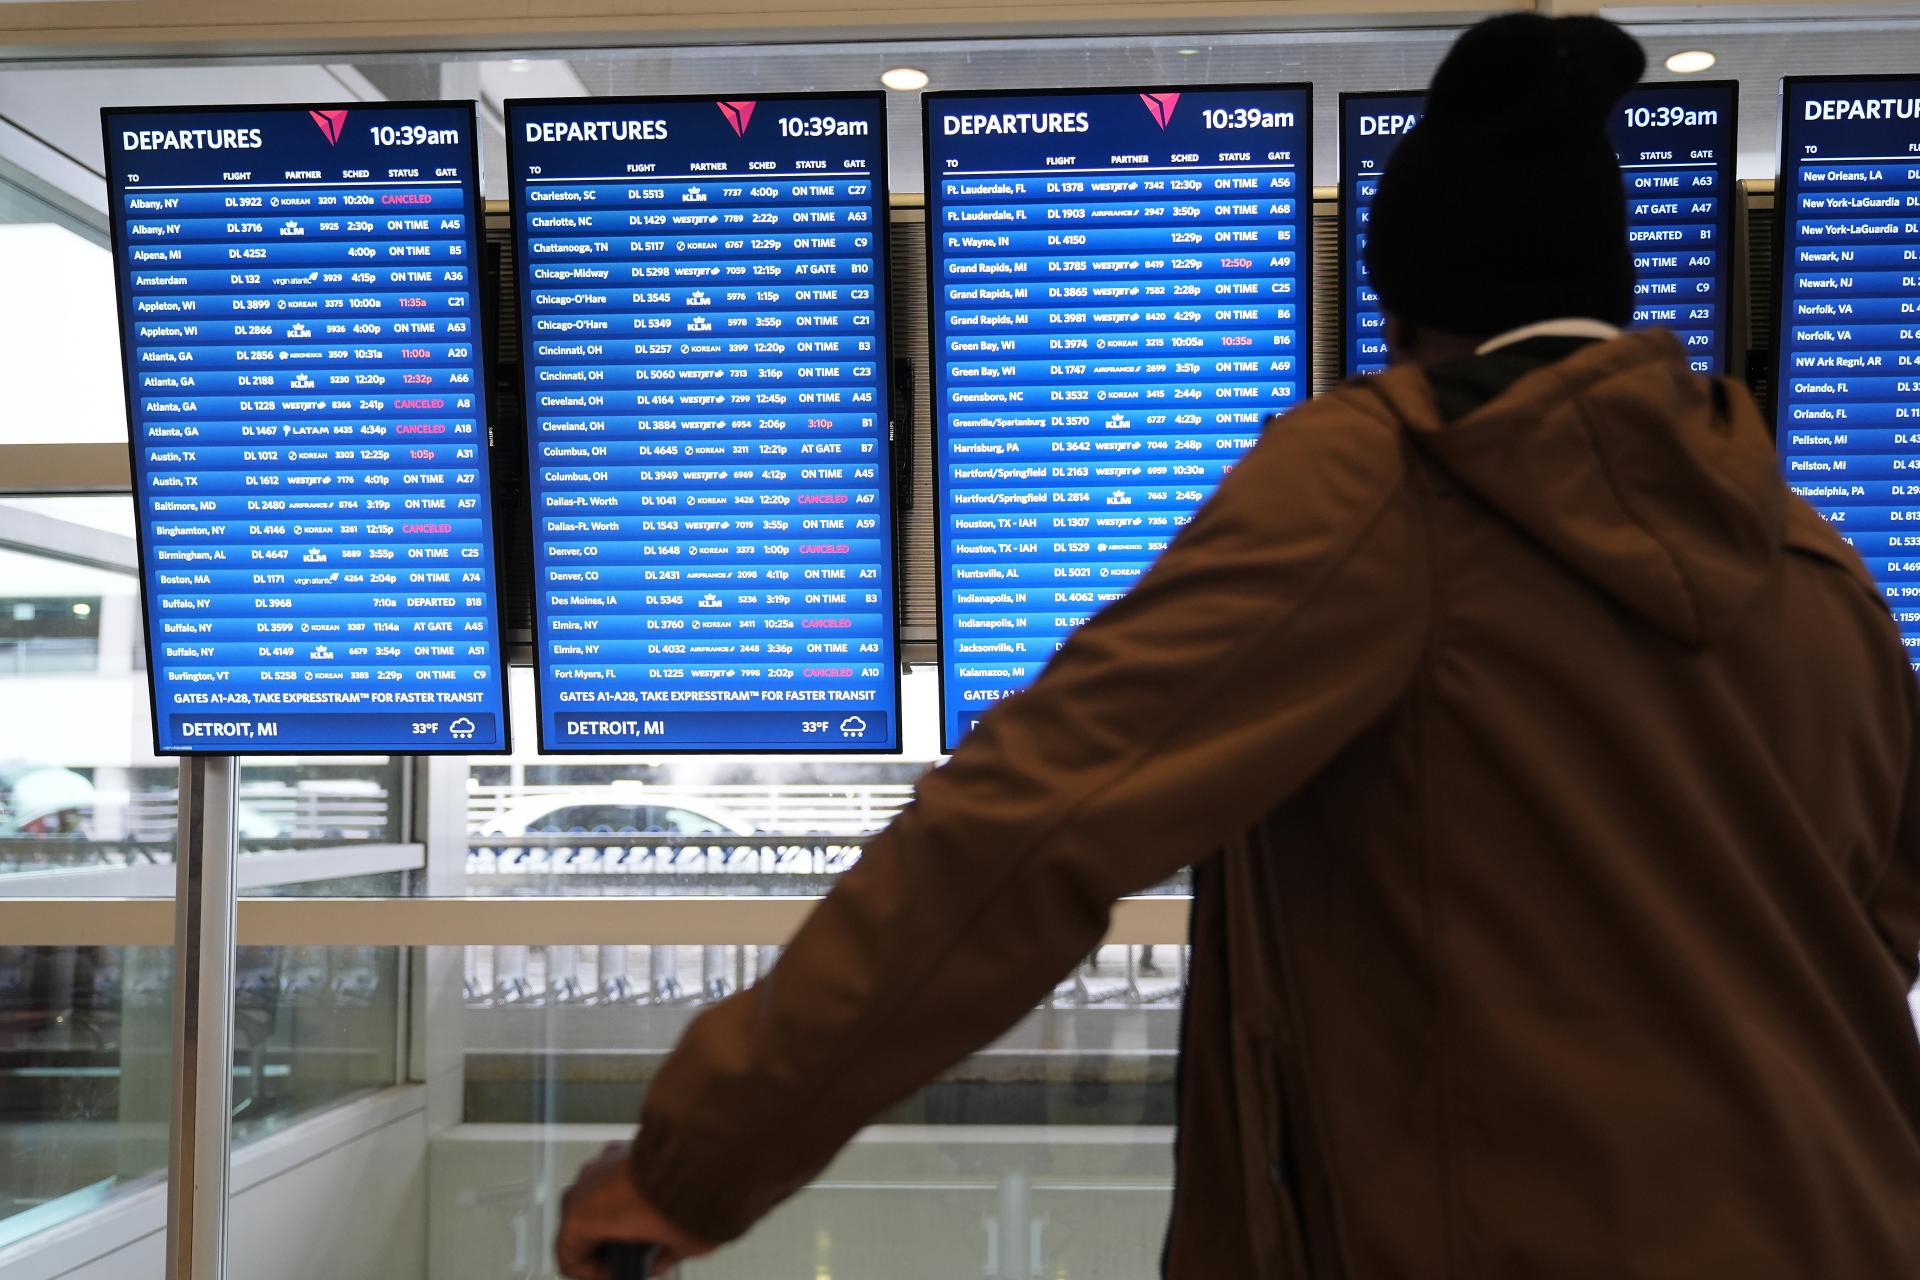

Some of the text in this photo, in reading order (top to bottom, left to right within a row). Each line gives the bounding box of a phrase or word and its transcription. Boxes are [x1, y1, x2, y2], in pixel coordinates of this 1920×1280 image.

[1202, 108, 1294, 129] 10:39am
[1624, 106, 1718, 128] 10:39am
[778, 116, 868, 137] 10:39am
[943, 112, 1089, 136] DEPARTURES
[370, 125, 459, 146] 10:39am
[525, 119, 668, 143] DEPARTURES
[122, 128, 263, 151] DEPARTURES
[1639, 149, 1713, 161] STATUS GATE
[1804, 145, 1818, 154] TO
[945, 151, 1291, 168] TO FLIGHT PARTNER SCHED STATUS GATE
[1361, 159, 1374, 169] TO
[528, 159, 866, 175] TO FLIGHT PARTNER SCHED STATUS GATE
[127, 168, 458, 183] TO FLIGHT PARTNER SCHED STATUS GATE
[1803, 170, 1883, 182] New Orleans, LA
[946, 177, 1291, 195] Ft. Lauderdale, FL DL 1378 12:30p ON TIME A56
[1634, 176, 1713, 188] ON TIME A63
[129, 198, 164, 210] Albany,
[164, 198, 179, 208] NY
[225, 197, 239, 207] DL
[239, 196, 263, 207] 3922
[281, 198, 311, 206] KOREAN
[342, 194, 375, 205] 10:20a
[380, 193, 433, 205] CANCELED
[1802, 196, 1900, 208] New York-LaGuardia
[1634, 203, 1712, 215] AT GATE A47
[532, 211, 868, 228] Charlotte, NC DL 1429 2:22p ON TIME A63
[1629, 229, 1711, 242] DEPARTED B1
[533, 242, 718, 254] Chattanooga, TN KOREAN
[1800, 251, 1854, 262] Newark, NJ
[948, 256, 1291, 275] Grand Rapids, MI 12:50p A49
[136, 271, 464, 286] Amsterdam DL 132 4:15p ON TIME A36
[1633, 309, 1710, 321] ON TIME A23
[1798, 304, 1853, 315] Norfolk, VA
[1362, 317, 1379, 327] Los
[1107, 335, 1291, 348] KOREAN B16
[1687, 335, 1709, 346] A70
[1362, 343, 1379, 353] Los
[142, 348, 431, 363] Atlanta, GA 11:00a
[1690, 361, 1708, 372] C15
[1796, 356, 1882, 368] NW Ark Regnl, AR
[1794, 382, 1849, 394] Orlando, FL
[951, 391, 1024, 403] Greensboro, NC
[292, 423, 473, 435] LATAM CANCELED A18
[542, 418, 833, 432] Cleveland, OH 3:10p
[1792, 434, 1848, 446] Pellston, MI
[1851, 486, 1865, 496] PA
[546, 493, 875, 507] Dallas-Ft. Worth 12:20p CANCELED A67
[156, 525, 226, 537] Binghamton, NY
[956, 568, 1019, 579] Huntsville, AL
[406, 597, 483, 607] DEPARTED B18
[554, 668, 617, 680] Fort Myers, FL
[959, 666, 1025, 678] Kalamazoo, MI
[173, 693, 209, 704] GATES
[210, 693, 252, 705] A1-A28,
[252, 692, 281, 704] TAKE
[371, 692, 394, 703] FOR
[394, 692, 435, 703] FASTER
[435, 692, 484, 703] TRANSIT
[963, 689, 1000, 701] GATES
[182, 722, 278, 739] DETROIT, MI
[567, 720, 665, 737] DETROIT, MI
